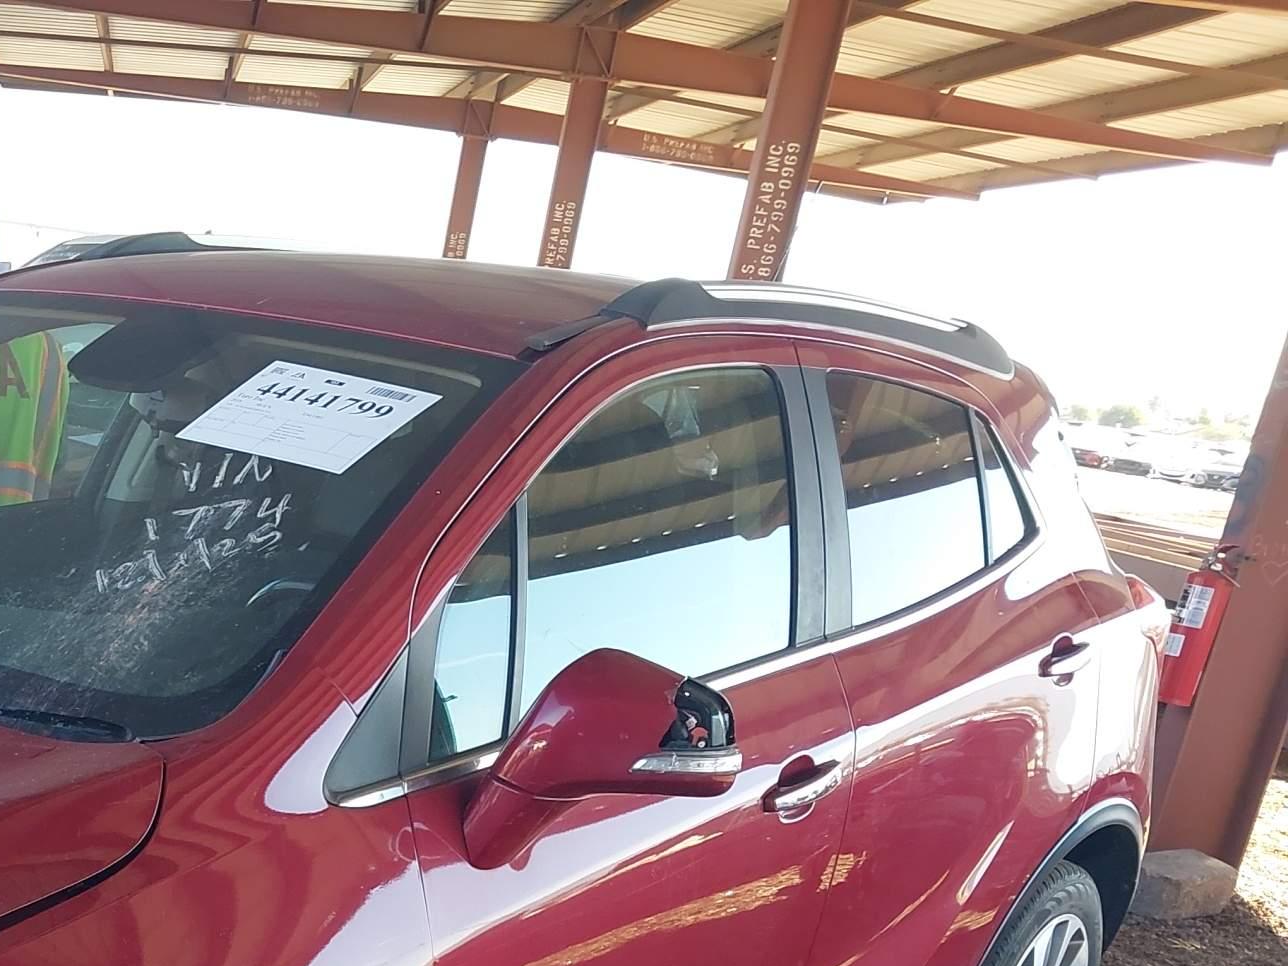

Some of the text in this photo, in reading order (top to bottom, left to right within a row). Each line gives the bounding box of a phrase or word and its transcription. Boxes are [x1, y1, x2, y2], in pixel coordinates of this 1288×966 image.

[746, 181, 775, 249] PREFAB
[764, 140, 786, 173] INC.
[256, 382, 394, 418] 44141799
